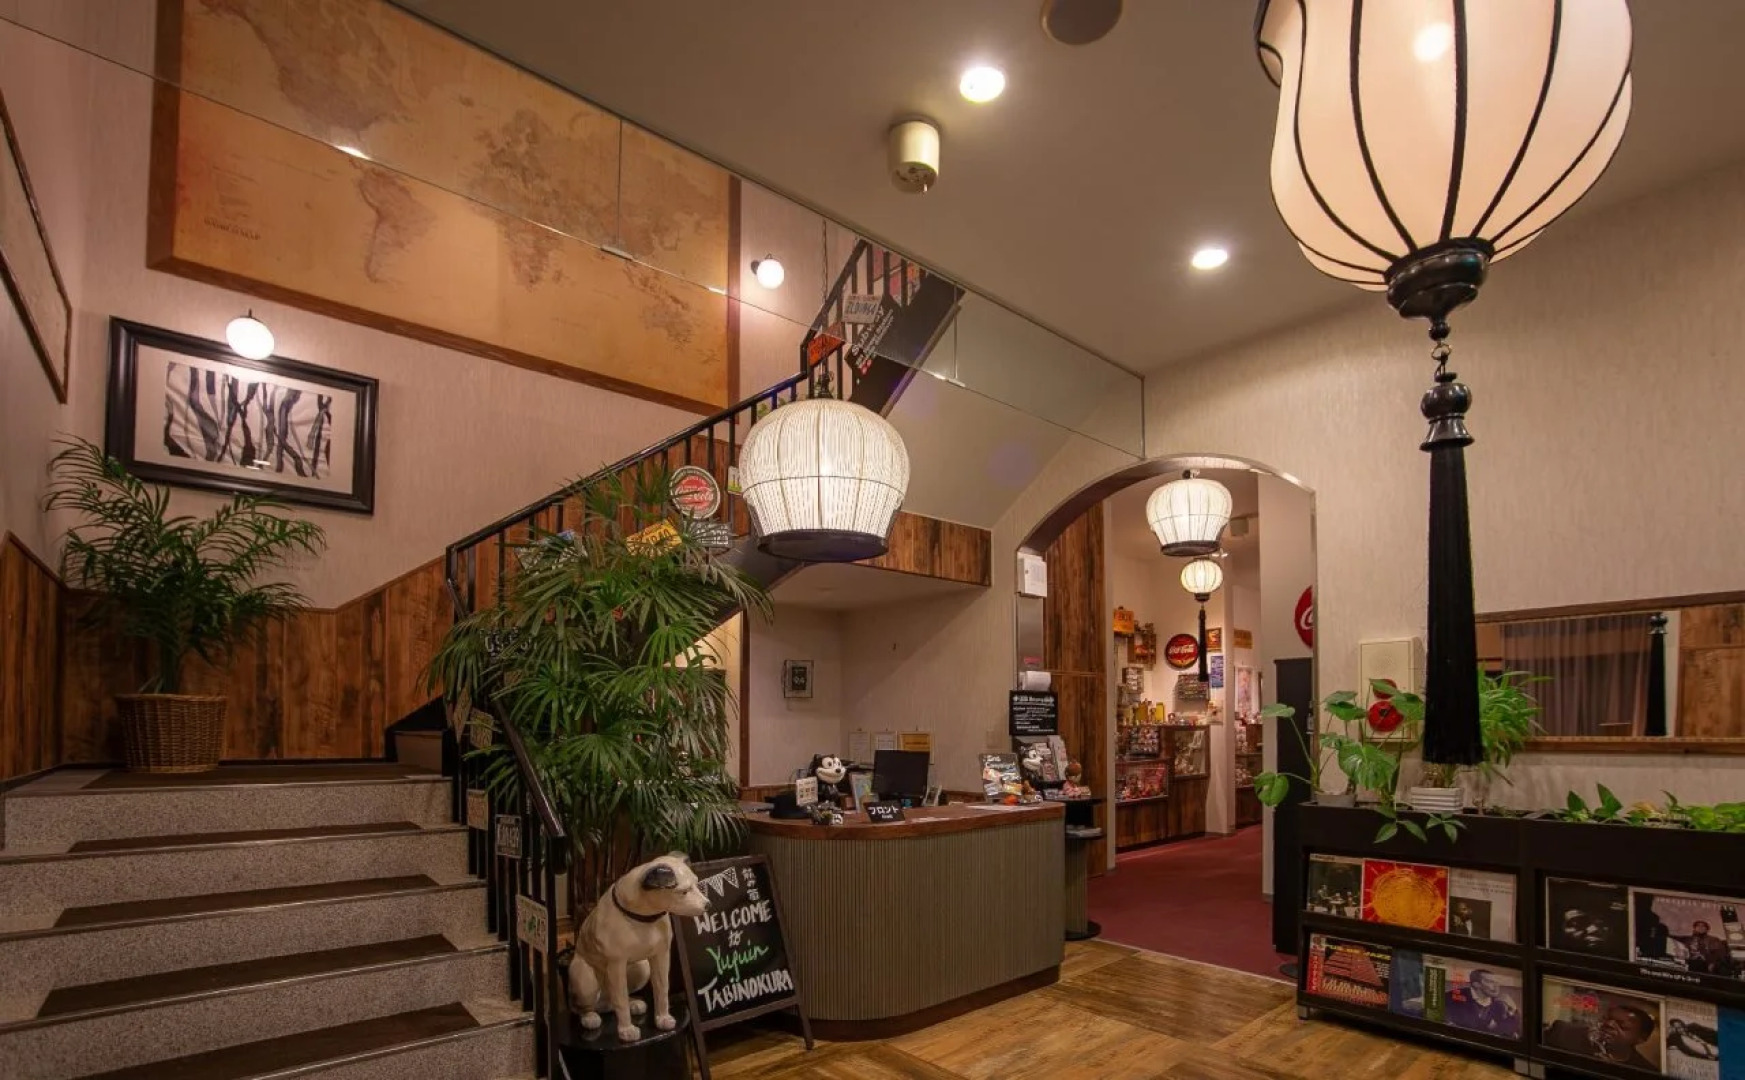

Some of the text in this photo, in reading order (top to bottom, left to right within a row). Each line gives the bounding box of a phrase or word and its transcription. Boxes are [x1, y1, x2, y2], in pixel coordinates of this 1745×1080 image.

[867, 804, 899, 815] フロント
[694, 900, 773, 935] WELCOME
